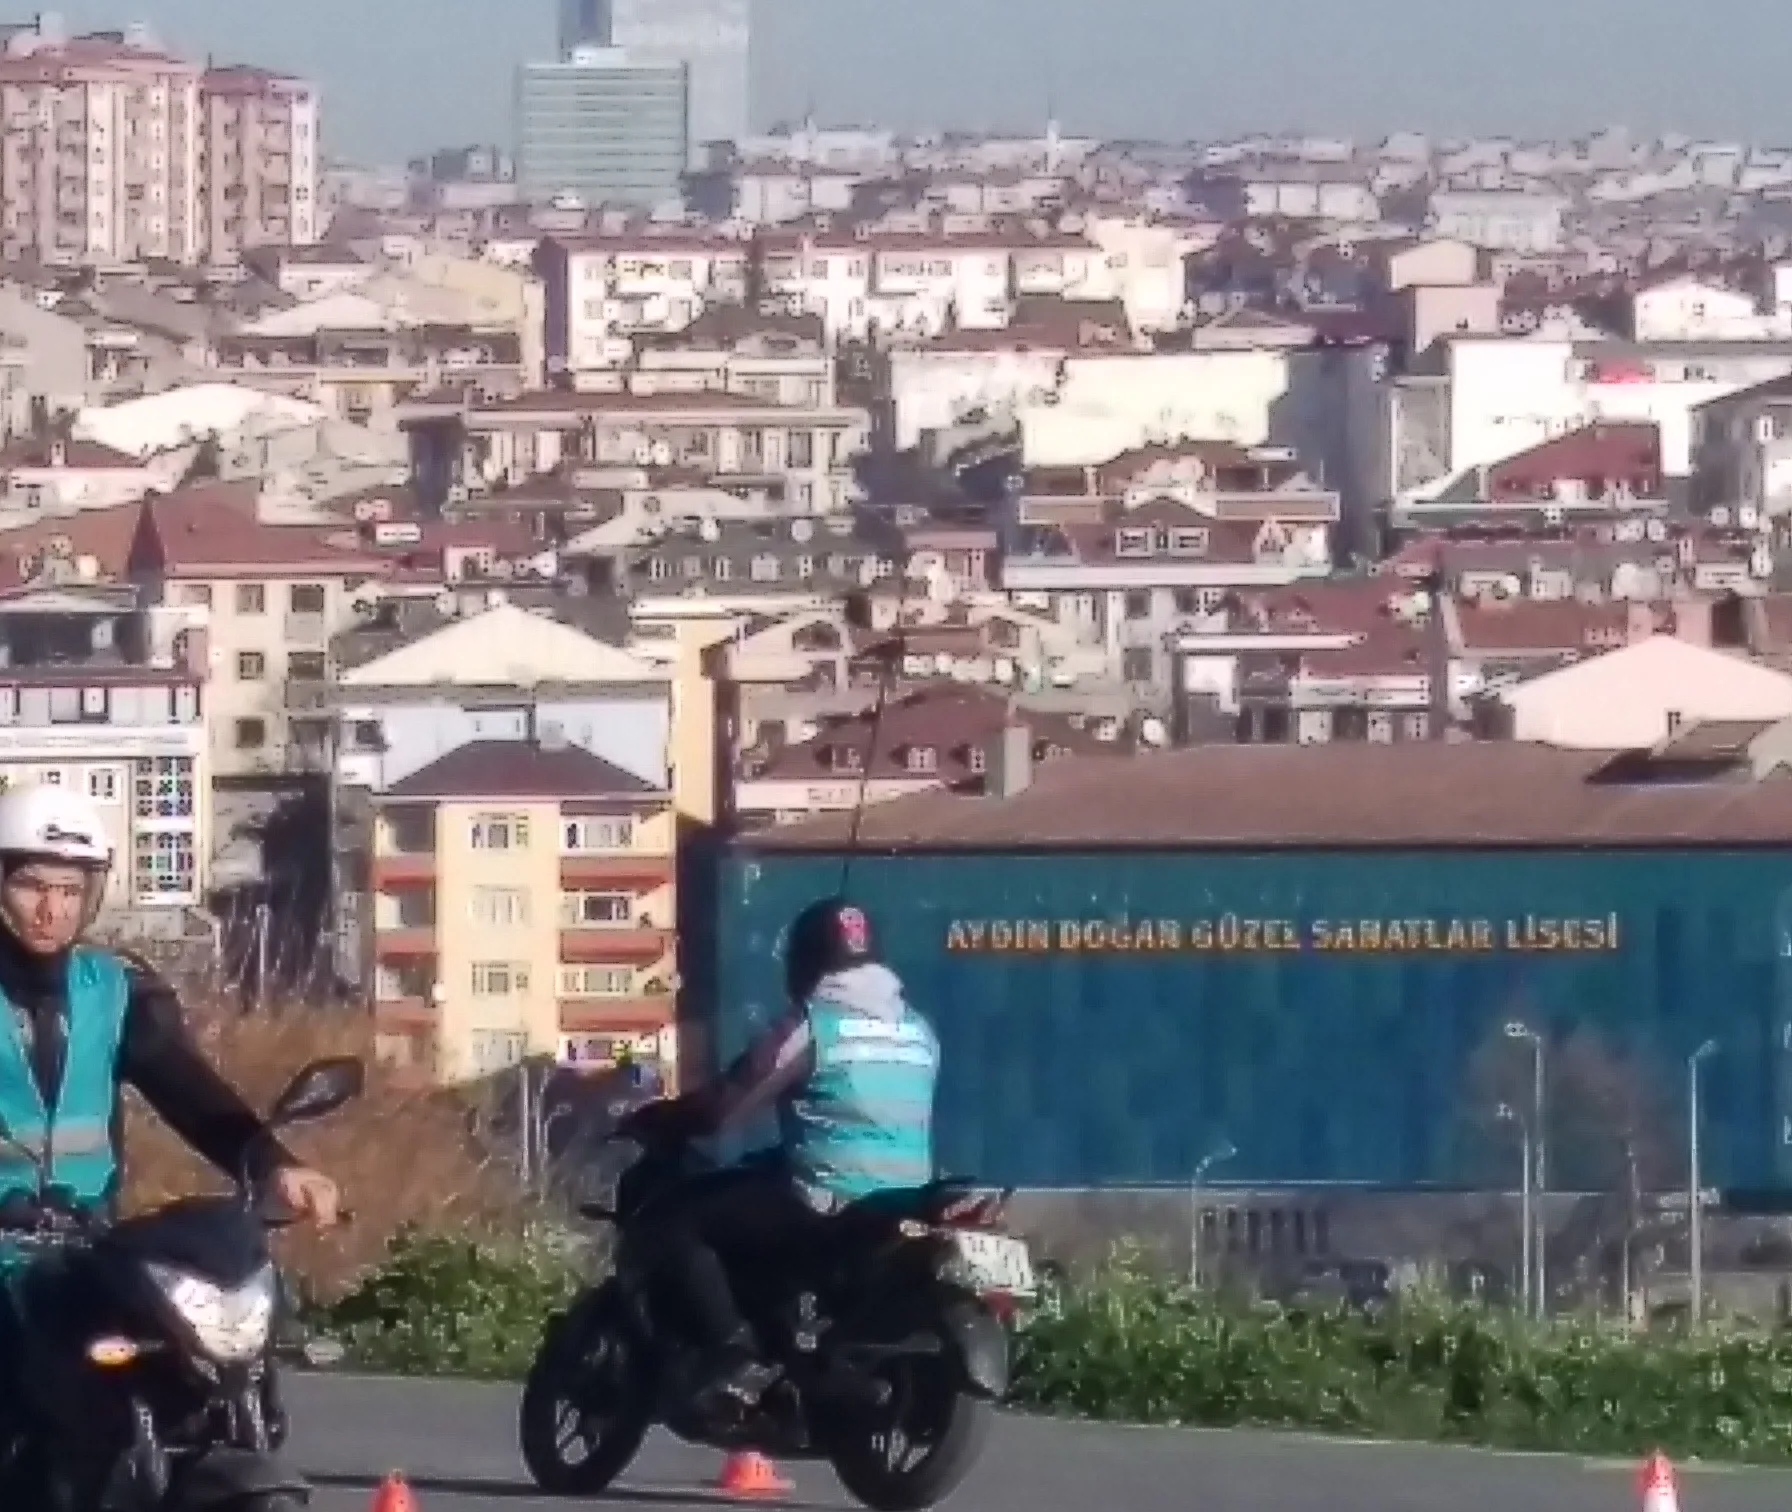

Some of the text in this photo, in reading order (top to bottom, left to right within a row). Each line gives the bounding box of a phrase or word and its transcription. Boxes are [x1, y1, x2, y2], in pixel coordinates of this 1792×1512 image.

[946, 911, 1617, 950] AYDIN DOĞAN GÜZEL SANATLAR LİSESİ
